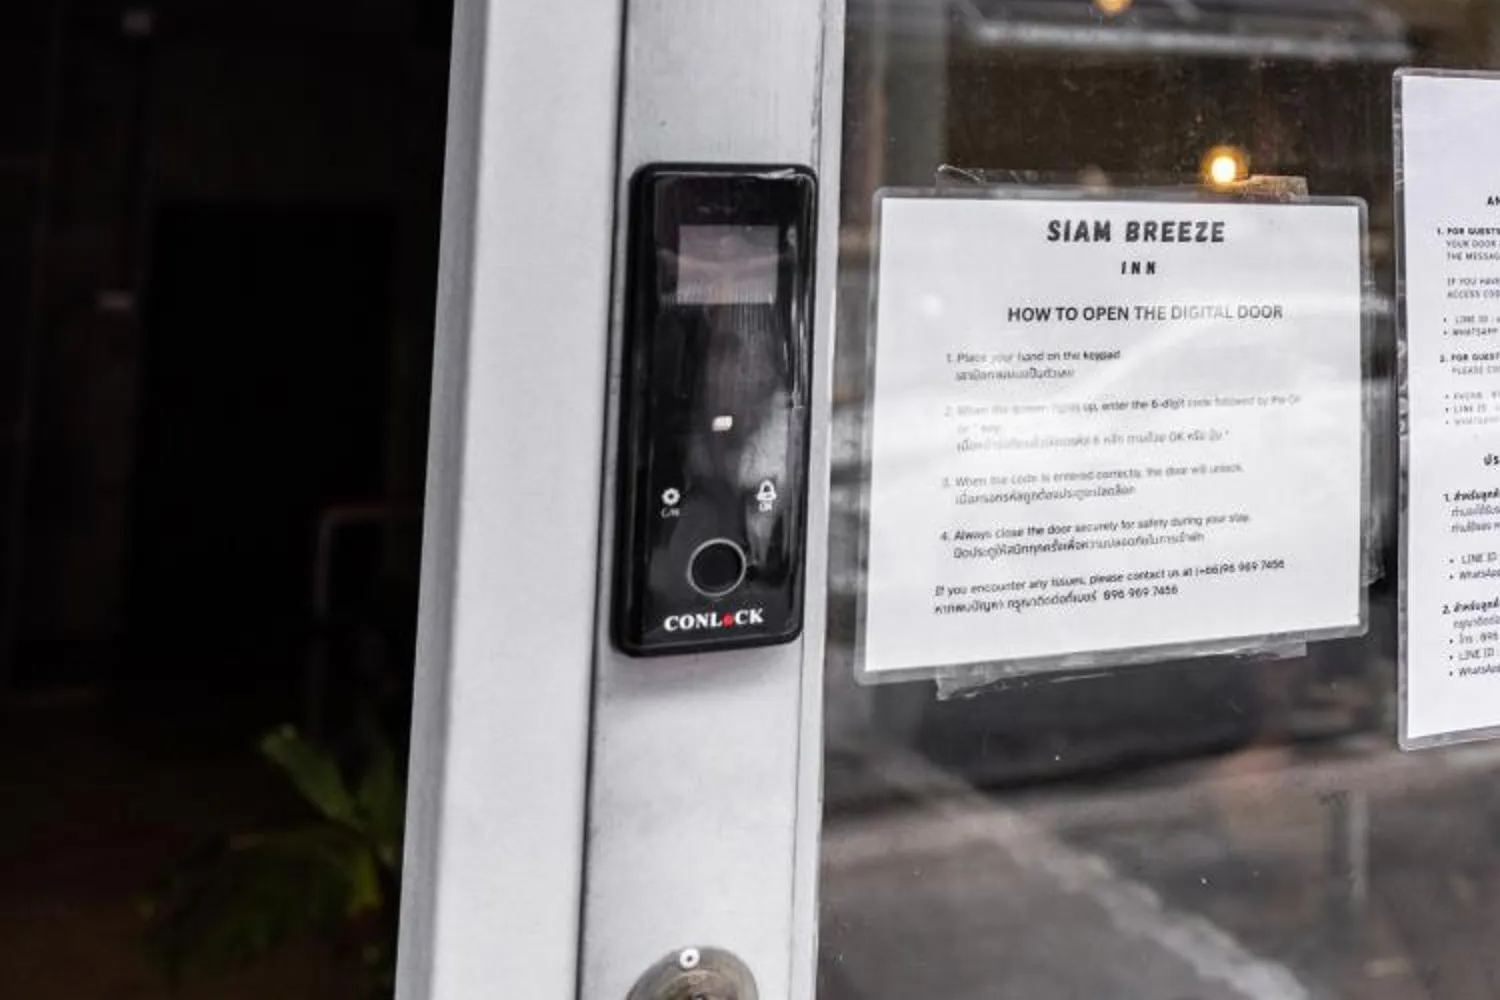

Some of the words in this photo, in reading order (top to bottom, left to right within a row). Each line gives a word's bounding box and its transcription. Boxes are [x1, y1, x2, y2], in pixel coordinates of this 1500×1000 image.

[1047, 220, 1112, 243] SIAM
[1125, 220, 1225, 243] BREEZE
[1121, 261, 1157, 276] INN
[1007, 307, 1051, 323] HOW
[1055, 307, 1078, 322] TO
[1083, 306, 1129, 322] OPEN
[1134, 306, 1167, 321] THE
[1171, 306, 1233, 321] DIGITAL
[1237, 305, 1283, 320] DOOR
[1018, 351, 1044, 362] hand
